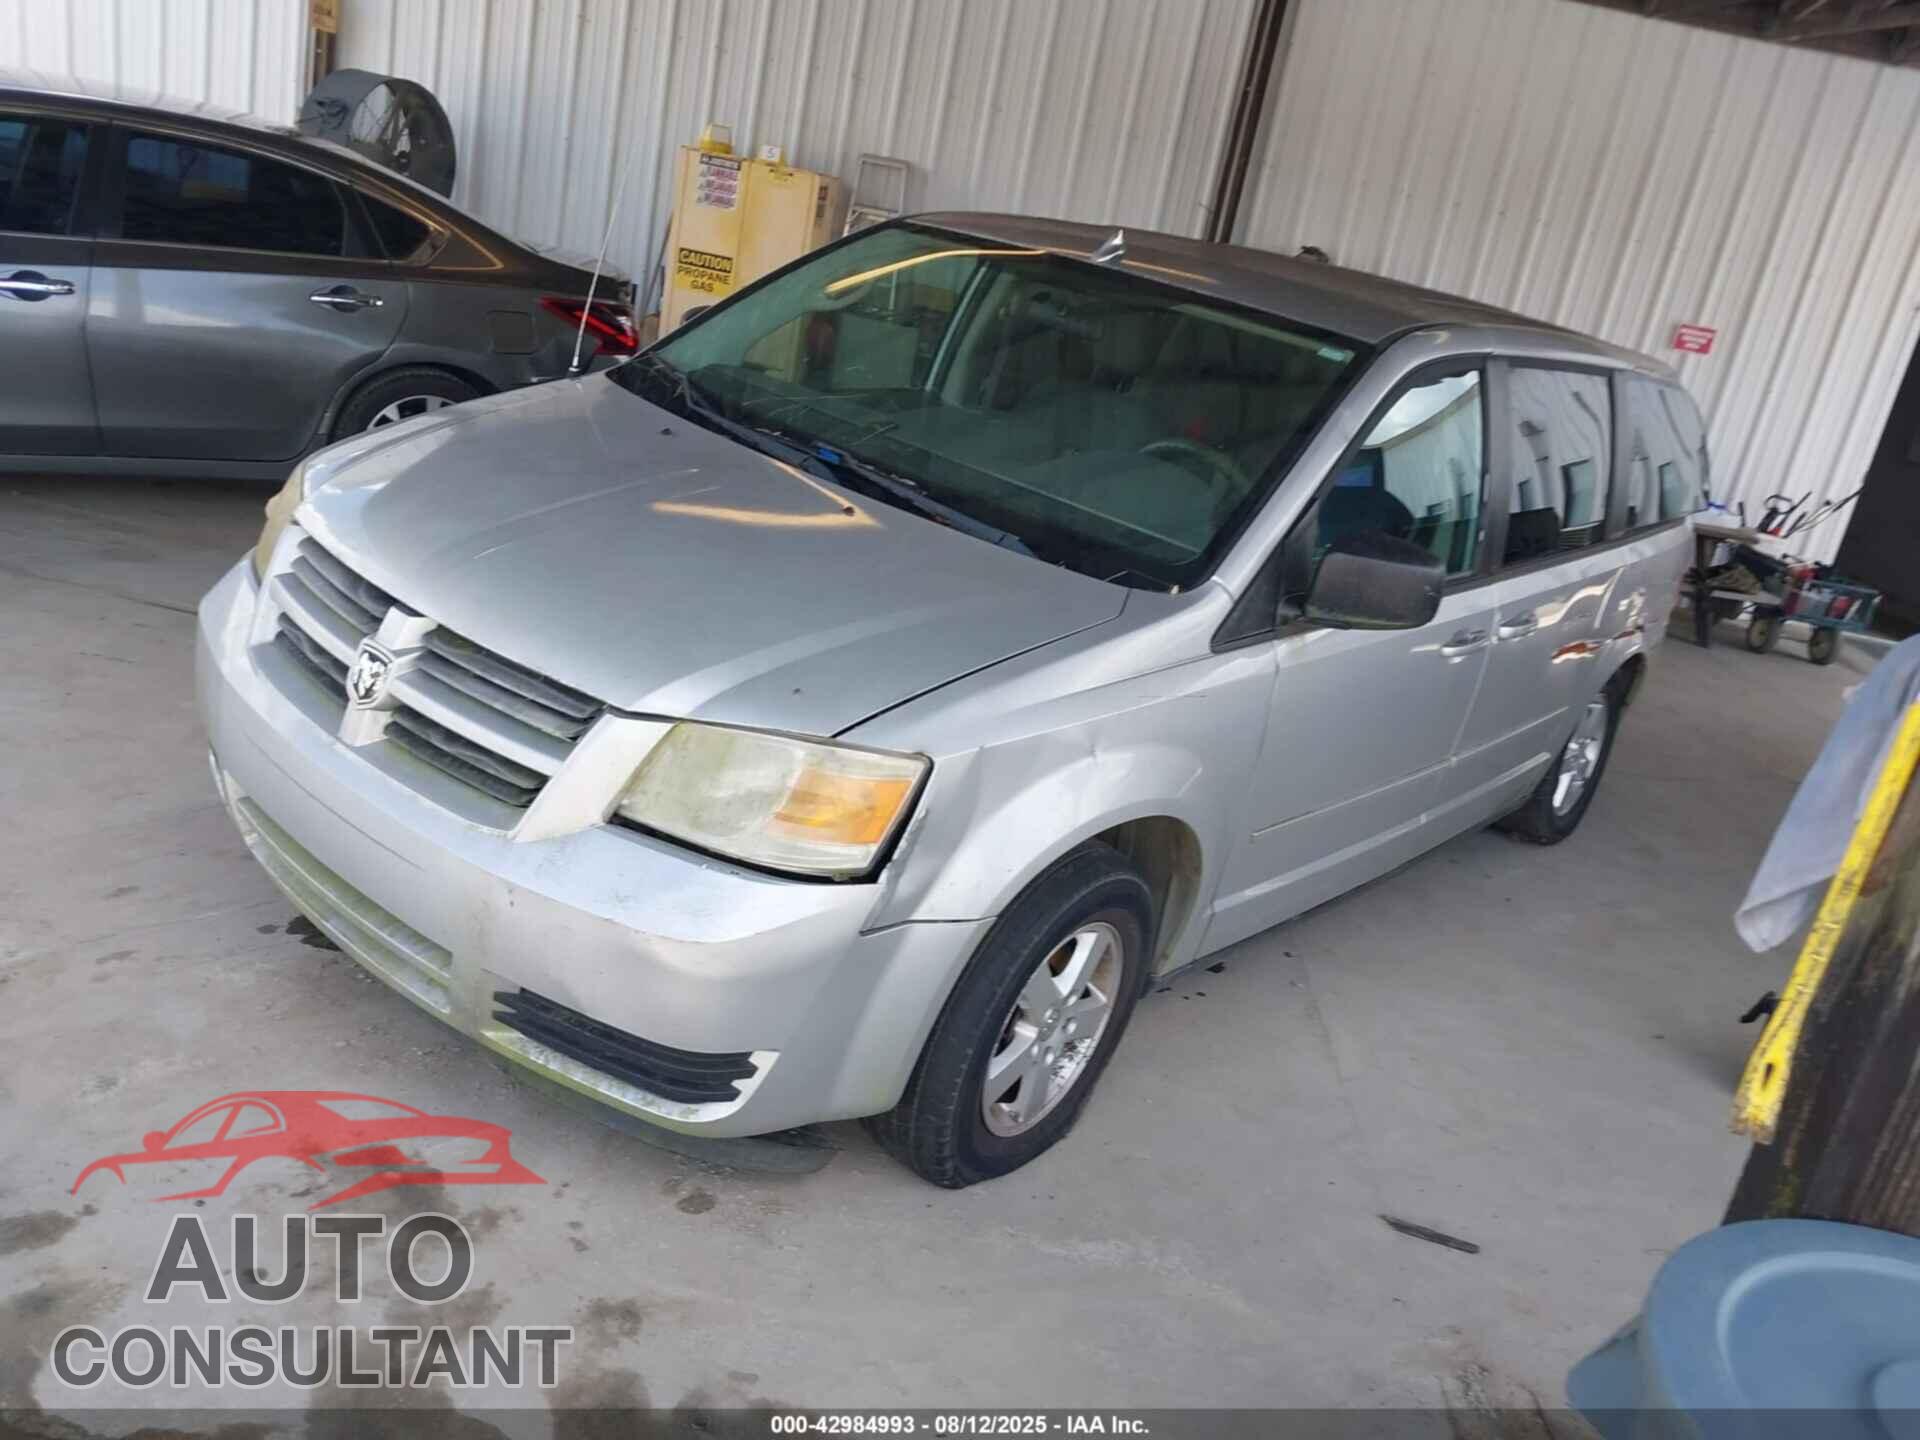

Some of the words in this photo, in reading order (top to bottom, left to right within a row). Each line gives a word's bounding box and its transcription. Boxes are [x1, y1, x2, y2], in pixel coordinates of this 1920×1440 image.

[680, 250, 732, 271] CAUTION
[677, 265, 731, 285] PROPANE
[690, 280, 714, 292] GAS
